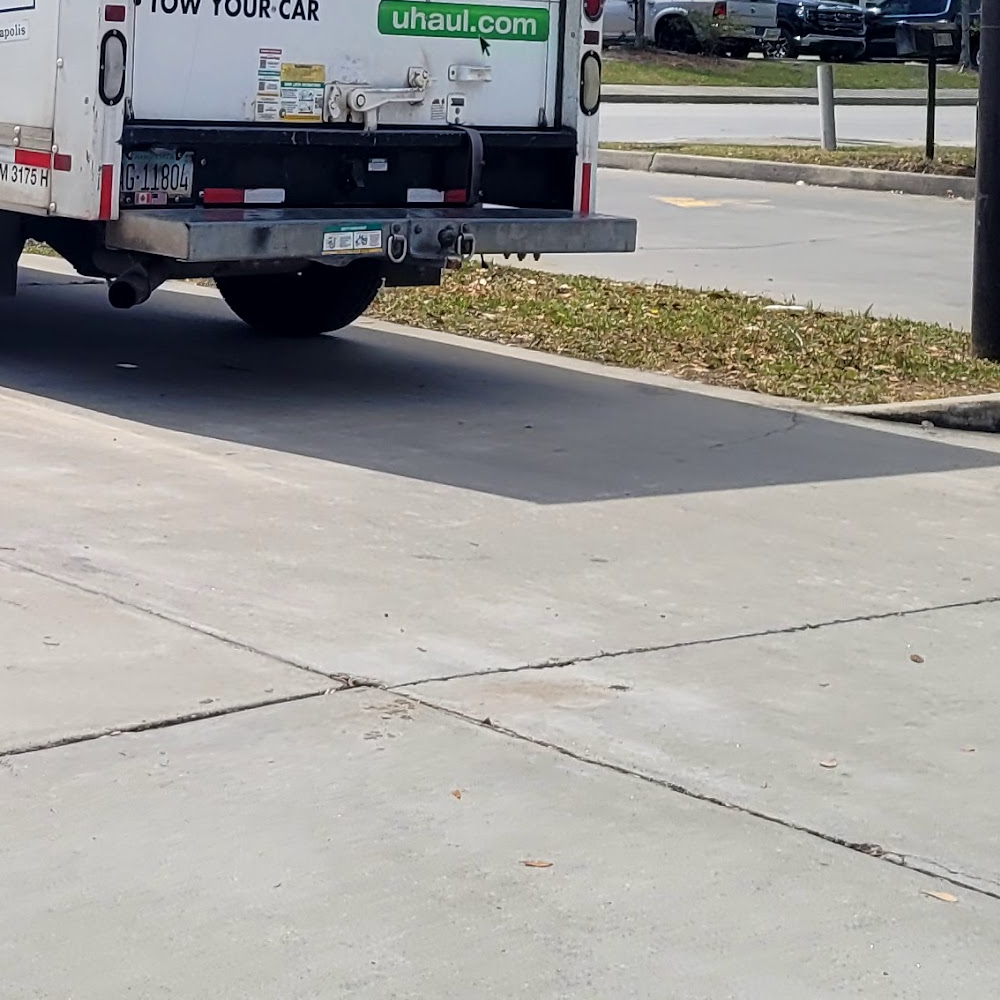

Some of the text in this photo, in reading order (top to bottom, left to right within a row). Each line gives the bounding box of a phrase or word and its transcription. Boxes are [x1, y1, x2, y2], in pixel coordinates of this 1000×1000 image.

[392, 6, 537, 36] uhaul.com
[11, 165, 37, 186] 3175
[40, 170, 49, 188] H
